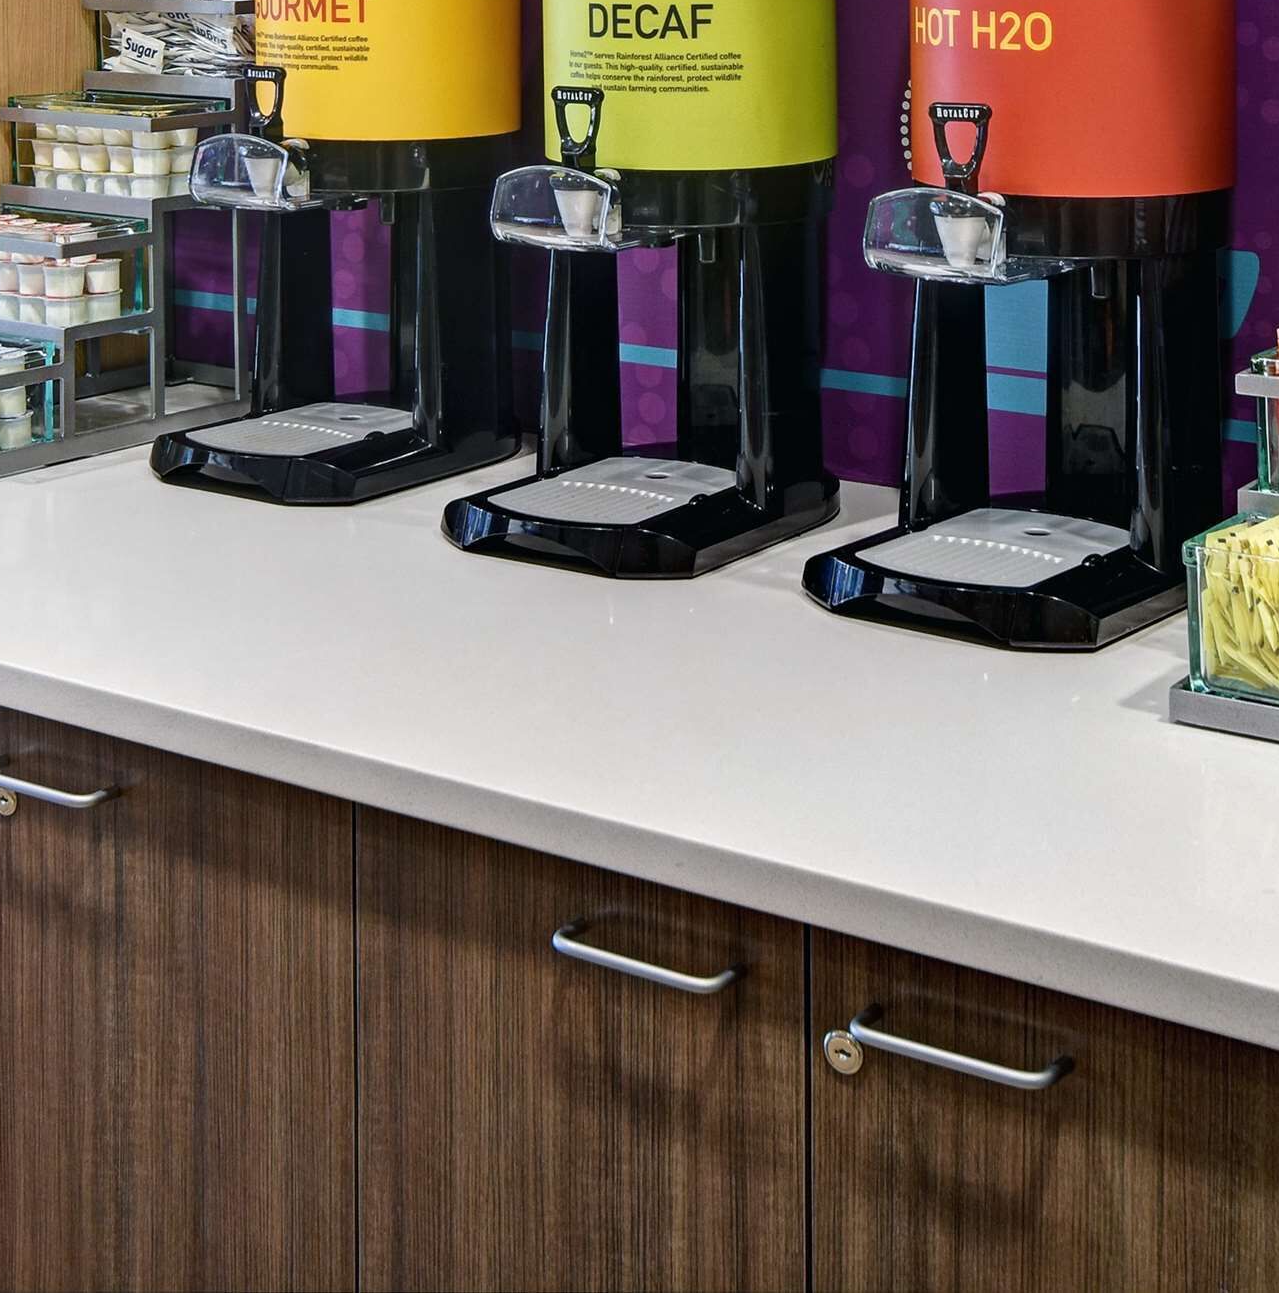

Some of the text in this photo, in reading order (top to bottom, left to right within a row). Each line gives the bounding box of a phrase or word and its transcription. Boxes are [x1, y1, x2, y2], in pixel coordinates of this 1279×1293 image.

[589, 3, 714, 39] DECAF
[915, 7, 1053, 51] HOT H2O
[124, 37, 158, 58] Sugar
[594, 52, 615, 60] serves
[616, 52, 653, 61] Rainforest
[654, 53, 684, 61] Alliance
[686, 52, 718, 61] Certified
[605, 62, 619, 70] This
[700, 63, 744, 71] sustainable
[602, 73, 632, 82] conserve
[633, 73, 645, 82] the
[687, 73, 713, 83] protect
[715, 73, 742, 82] wildlife
[603, 84, 627, 92] sustain
[628, 84, 657, 93] farming
[658, 85, 710, 93] communities.
